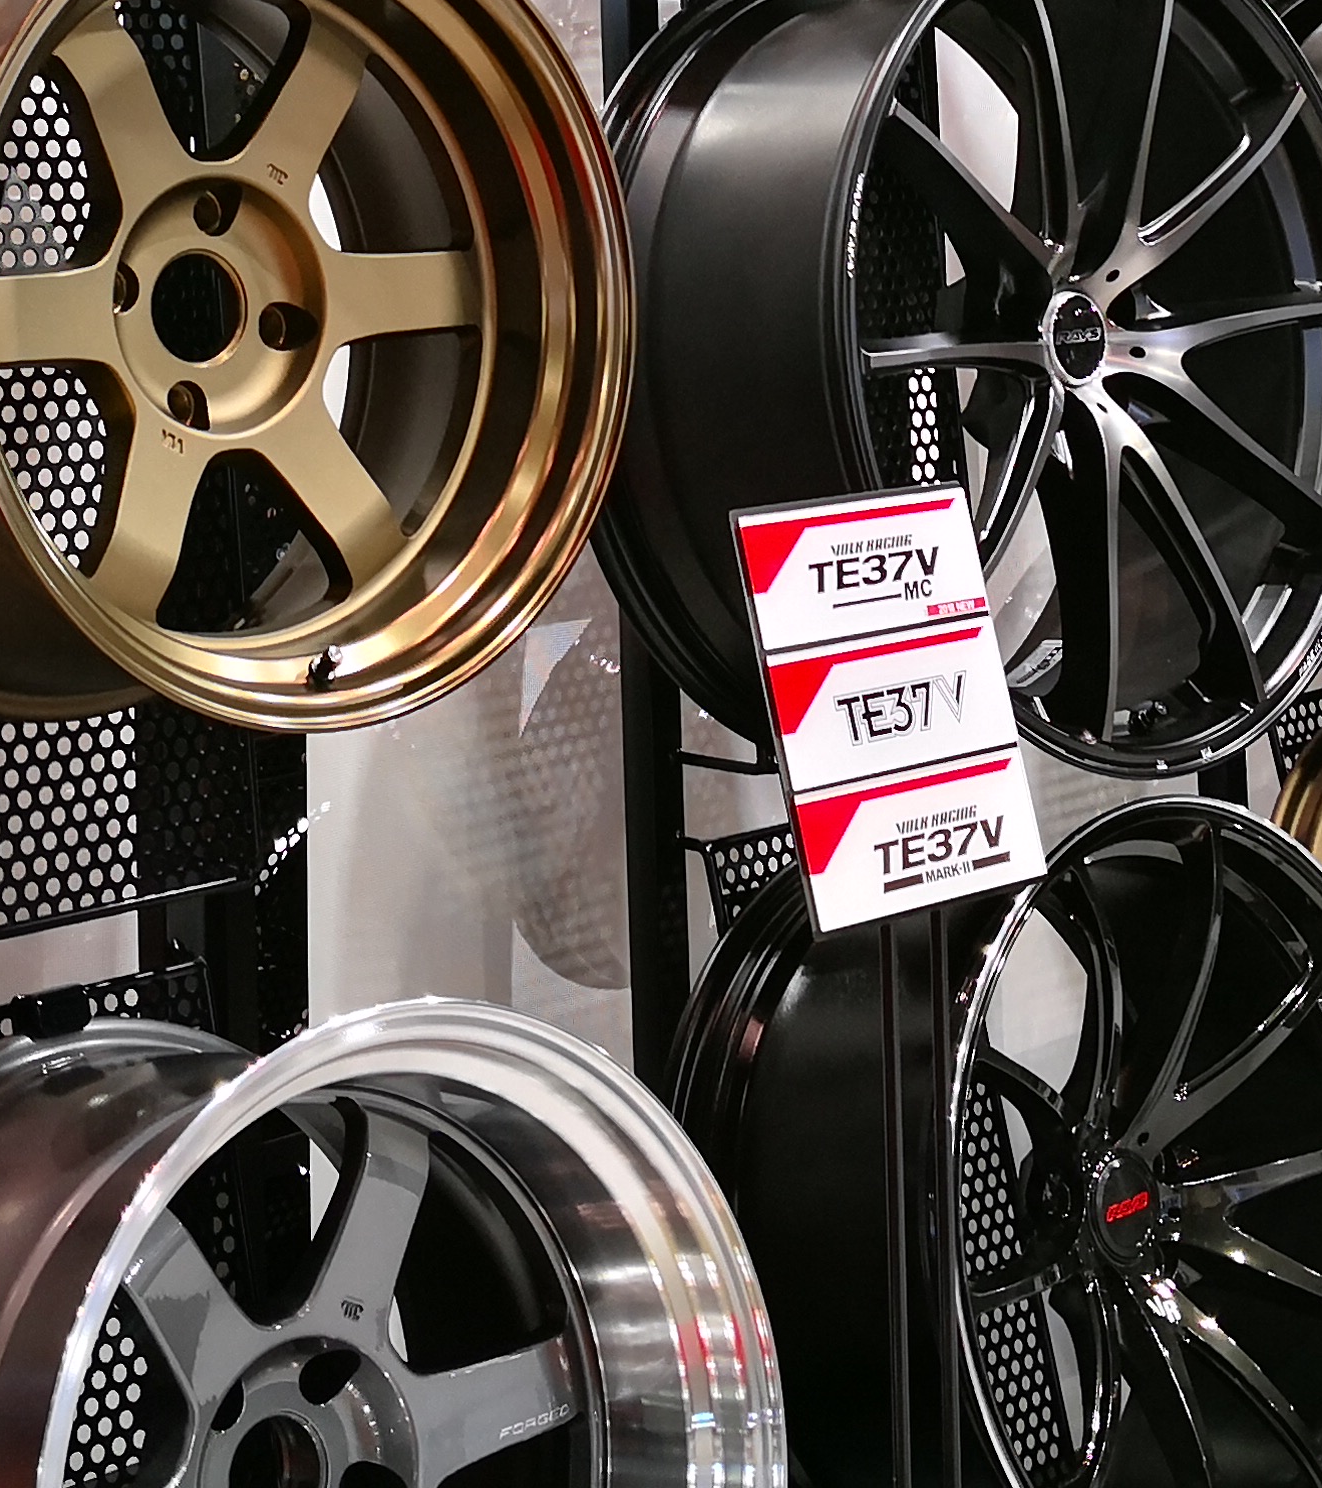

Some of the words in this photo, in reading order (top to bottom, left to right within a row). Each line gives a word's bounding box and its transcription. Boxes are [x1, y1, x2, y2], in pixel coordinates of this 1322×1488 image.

[1055, 327, 1102, 345] RAYS
[808, 546, 939, 594] TE37V
[904, 579, 932, 601] MC
[833, 670, 967, 747] TE37V
[874, 815, 1004, 875] TE37V
[499, 1403, 570, 1440] FORGED
